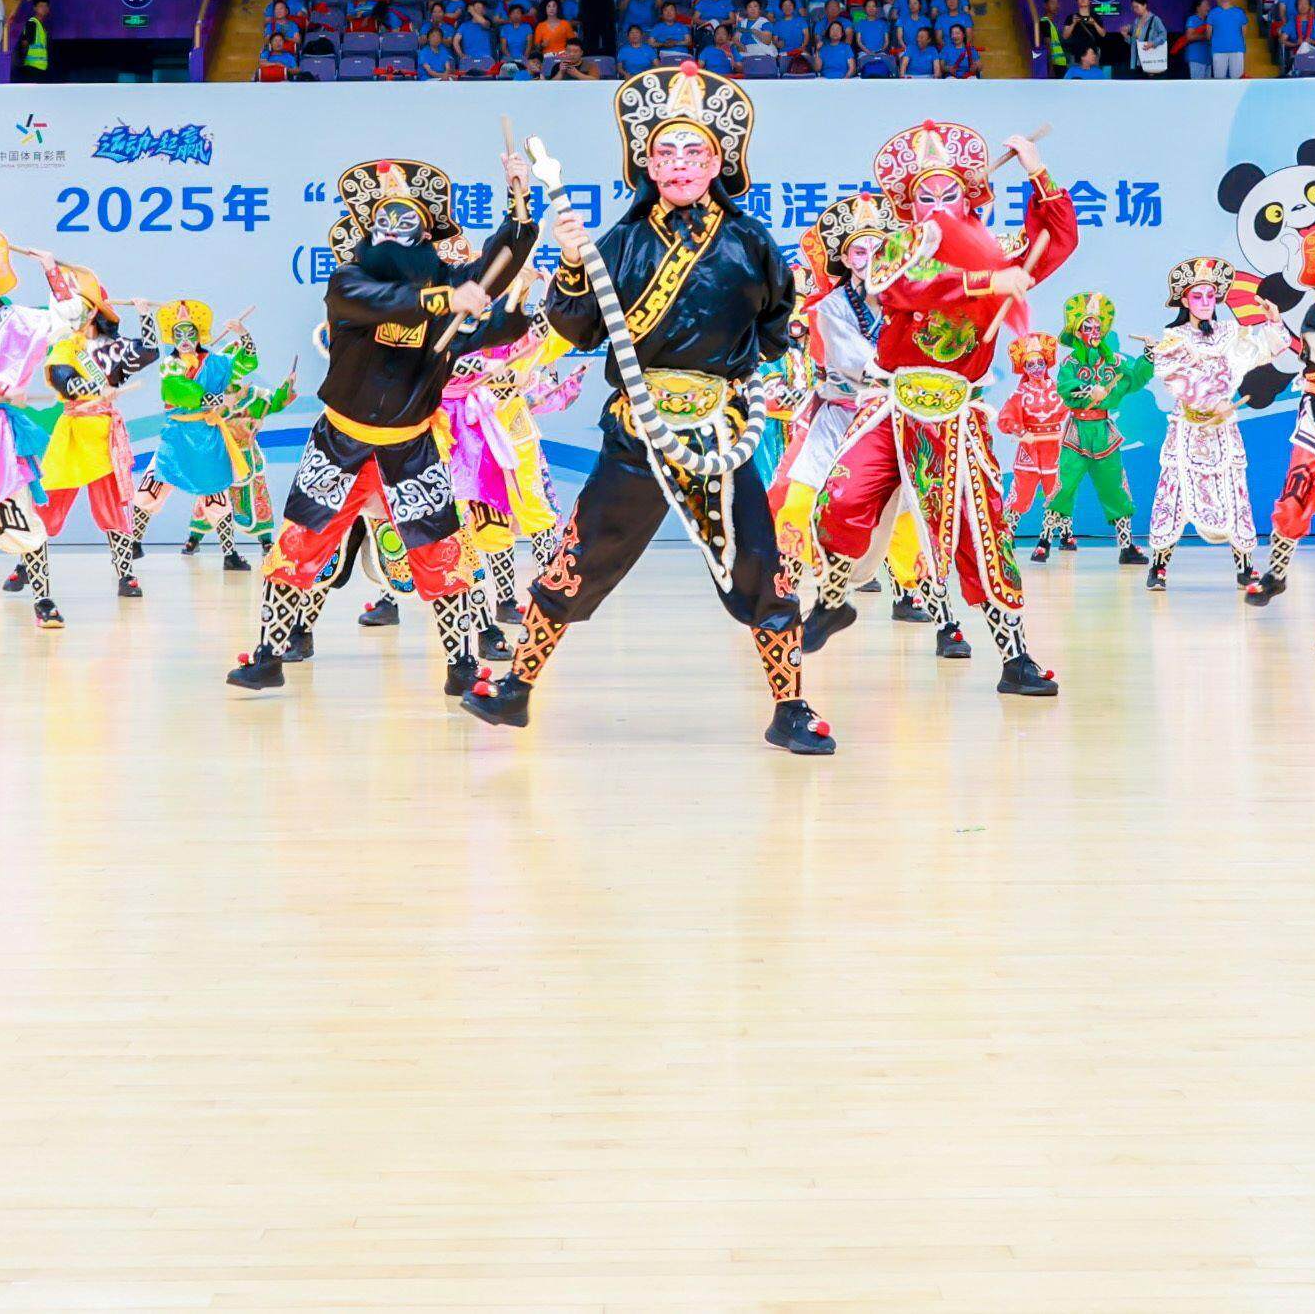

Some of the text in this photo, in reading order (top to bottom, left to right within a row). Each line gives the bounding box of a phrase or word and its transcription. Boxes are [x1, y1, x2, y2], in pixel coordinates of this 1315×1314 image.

[92, 120, 214, 166] 运动一起赢
